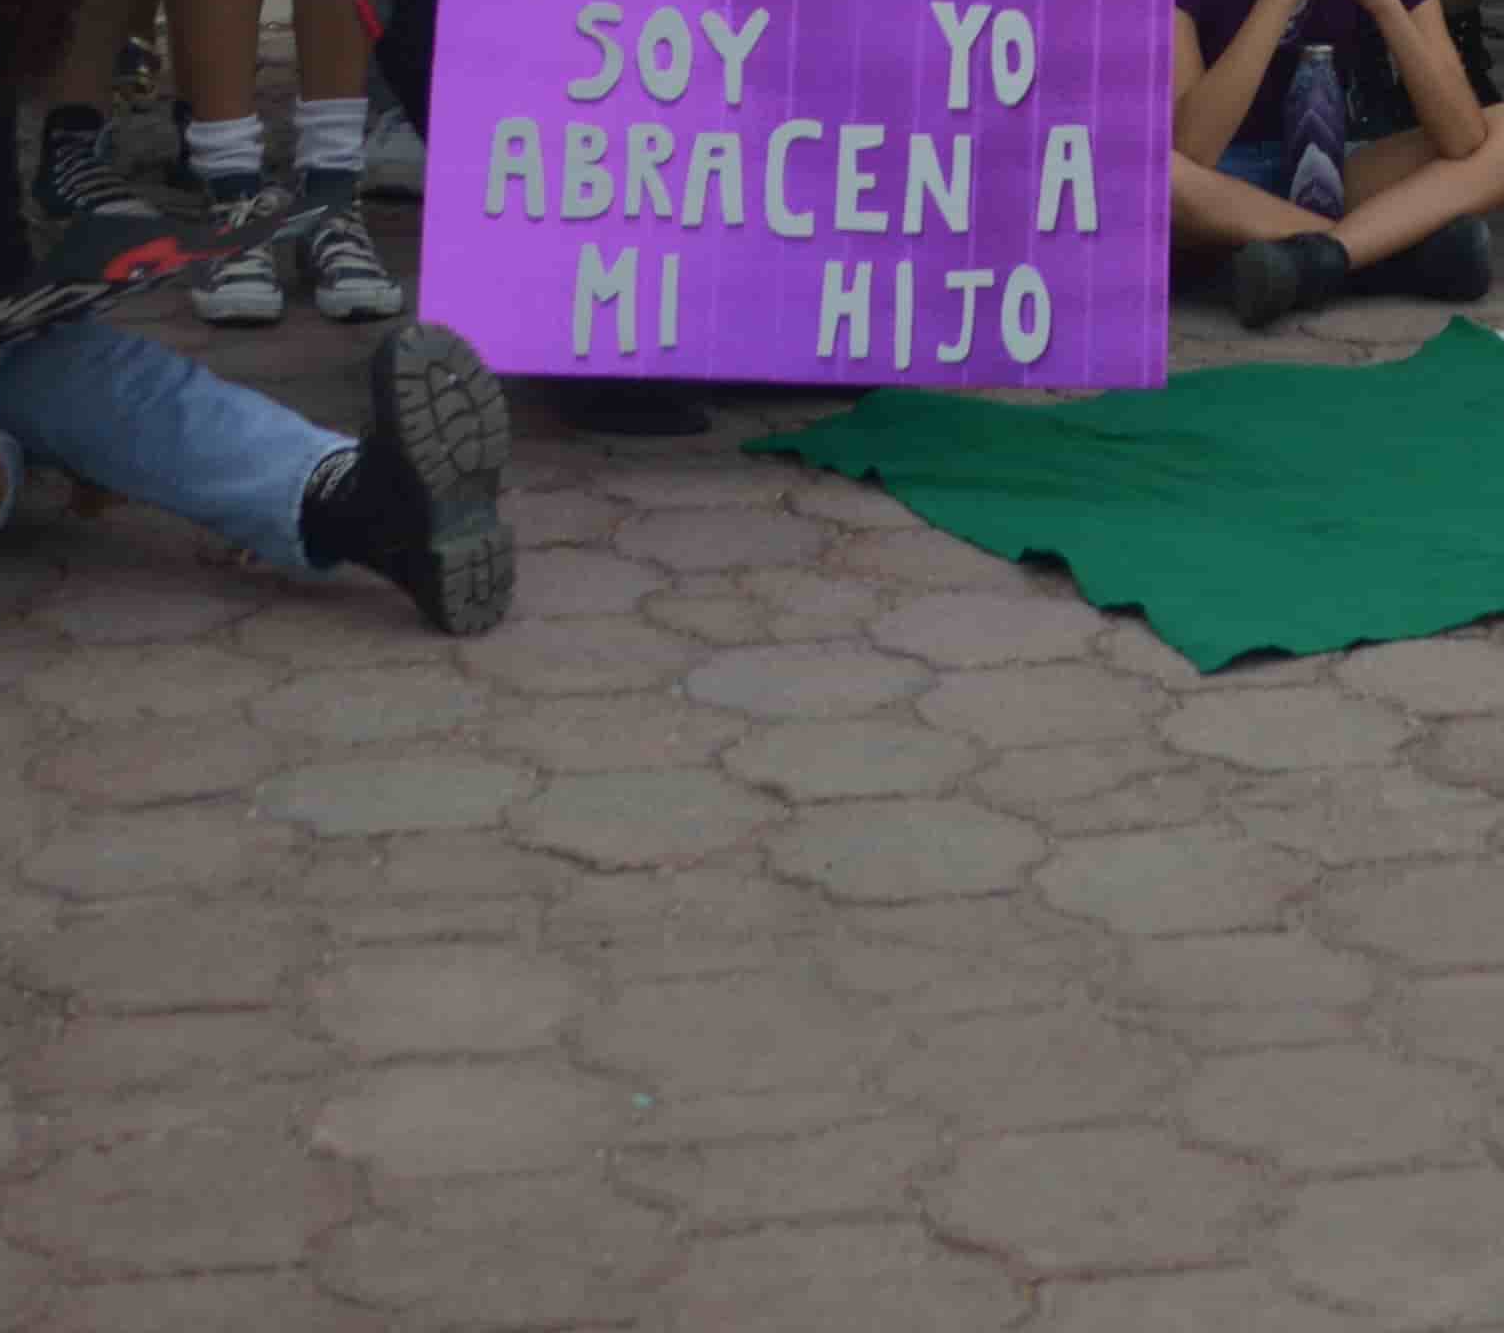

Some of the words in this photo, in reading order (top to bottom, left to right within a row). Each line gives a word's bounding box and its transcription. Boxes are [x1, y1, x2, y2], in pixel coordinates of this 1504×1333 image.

[566, 1, 770, 105] SOY
[930, 0, 1037, 110] YO
[484, 118, 971, 238] ABRACEN
[1037, 124, 1098, 233] A
[572, 243, 679, 357] MI
[816, 260, 1052, 370] HIJO
